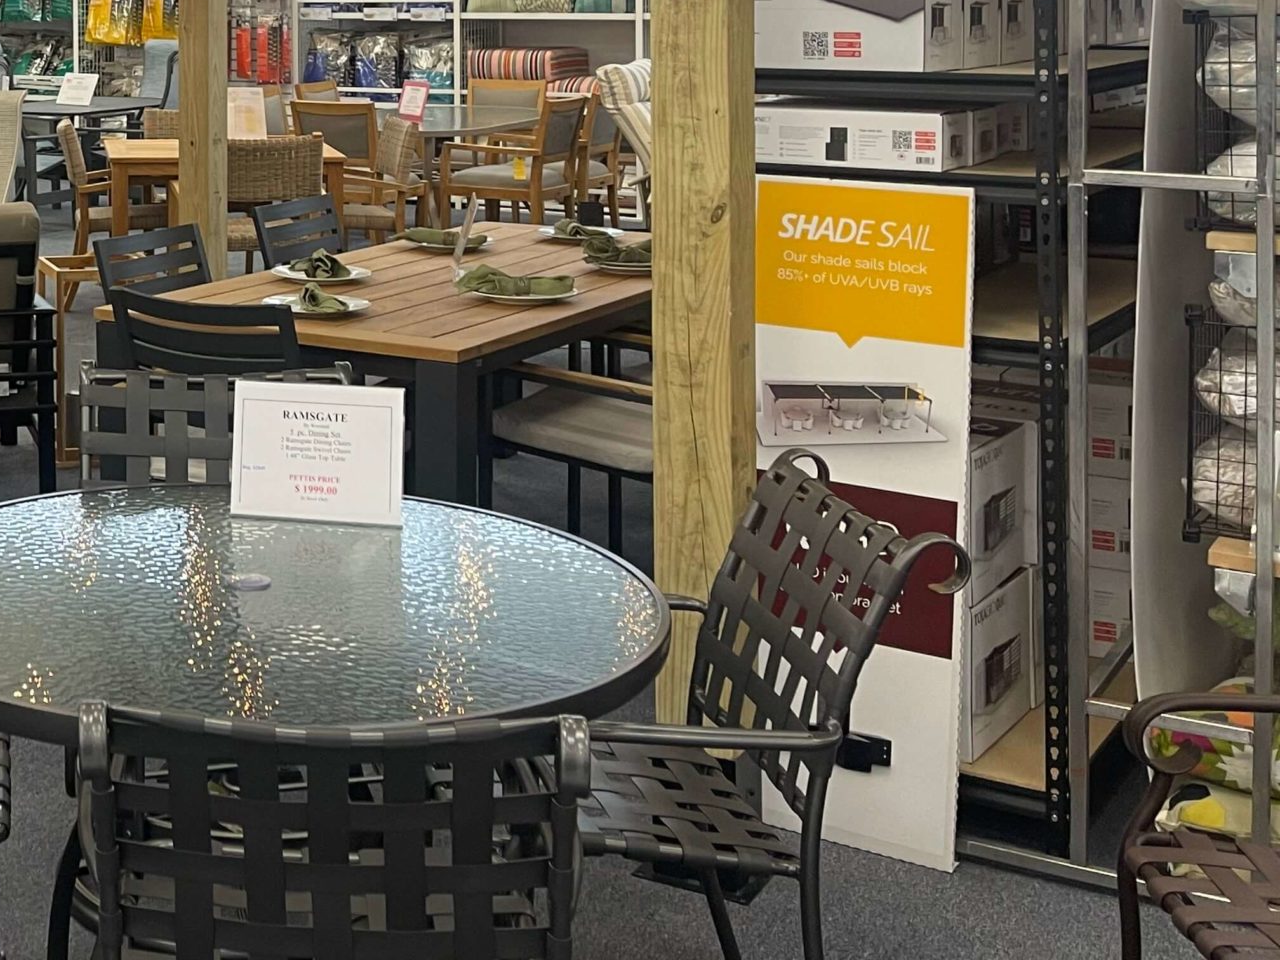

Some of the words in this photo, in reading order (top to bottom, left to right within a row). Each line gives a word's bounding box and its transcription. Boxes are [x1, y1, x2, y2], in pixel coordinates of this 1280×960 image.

[778, 212, 876, 246] SHADE
[876, 220, 936, 252] SAIL
[783, 250, 808, 264] Our
[810, 251, 852, 268] shade
[855, 256, 885, 272] sails
[888, 259, 928, 275] block
[813, 271, 827, 284] of
[829, 273, 900, 292] UVA/UVB
[903, 282, 933, 296] rays
[283, 410, 349, 423] RAMSGATE
[303, 485, 338, 495] 1999.00
